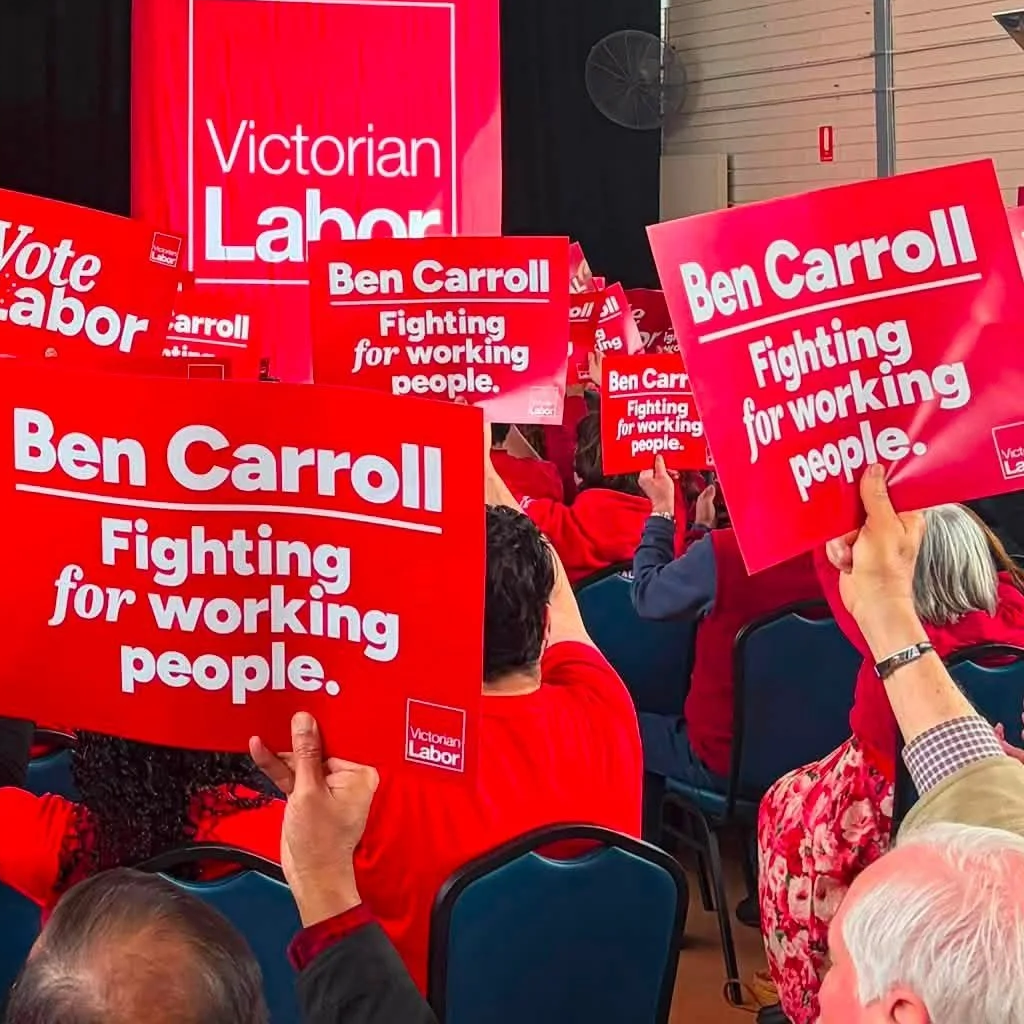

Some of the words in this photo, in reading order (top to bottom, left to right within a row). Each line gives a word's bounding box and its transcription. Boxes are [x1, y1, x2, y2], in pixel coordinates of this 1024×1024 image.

[205, 118, 441, 178] Victorian
[151, 252, 176, 265] Labor
[328, 261, 403, 296] Ben
[412, 258, 550, 295] Carroll
[680, 261, 763, 324] Ben
[764, 204, 977, 300] Carroll
[168, 310, 250, 340] arroll
[379, 308, 506, 342] Fighting
[351, 338, 400, 374] for
[406, 336, 529, 372] working
[748, 316, 913, 393] Fighting
[391, 366, 500, 400] people.
[609, 370, 639, 392] Ben
[642, 367, 689, 389] Carr
[627, 397, 689, 420] Fighting
[742, 397, 784, 464] for
[789, 360, 971, 433] working
[616, 417, 636, 441] for
[637, 416, 703, 437] working
[631, 434, 685, 457] people.
[13, 407, 146, 487] Ben
[167, 424, 443, 513] Carroll
[789, 421, 928, 502] people.
[101, 516, 351, 595] Fighting
[48, 563, 136, 627] for
[147, 584, 400, 662] working
[120, 641, 340, 705] people.
[408, 739, 461, 766] Labor
[409, 726, 462, 749] Victorian
